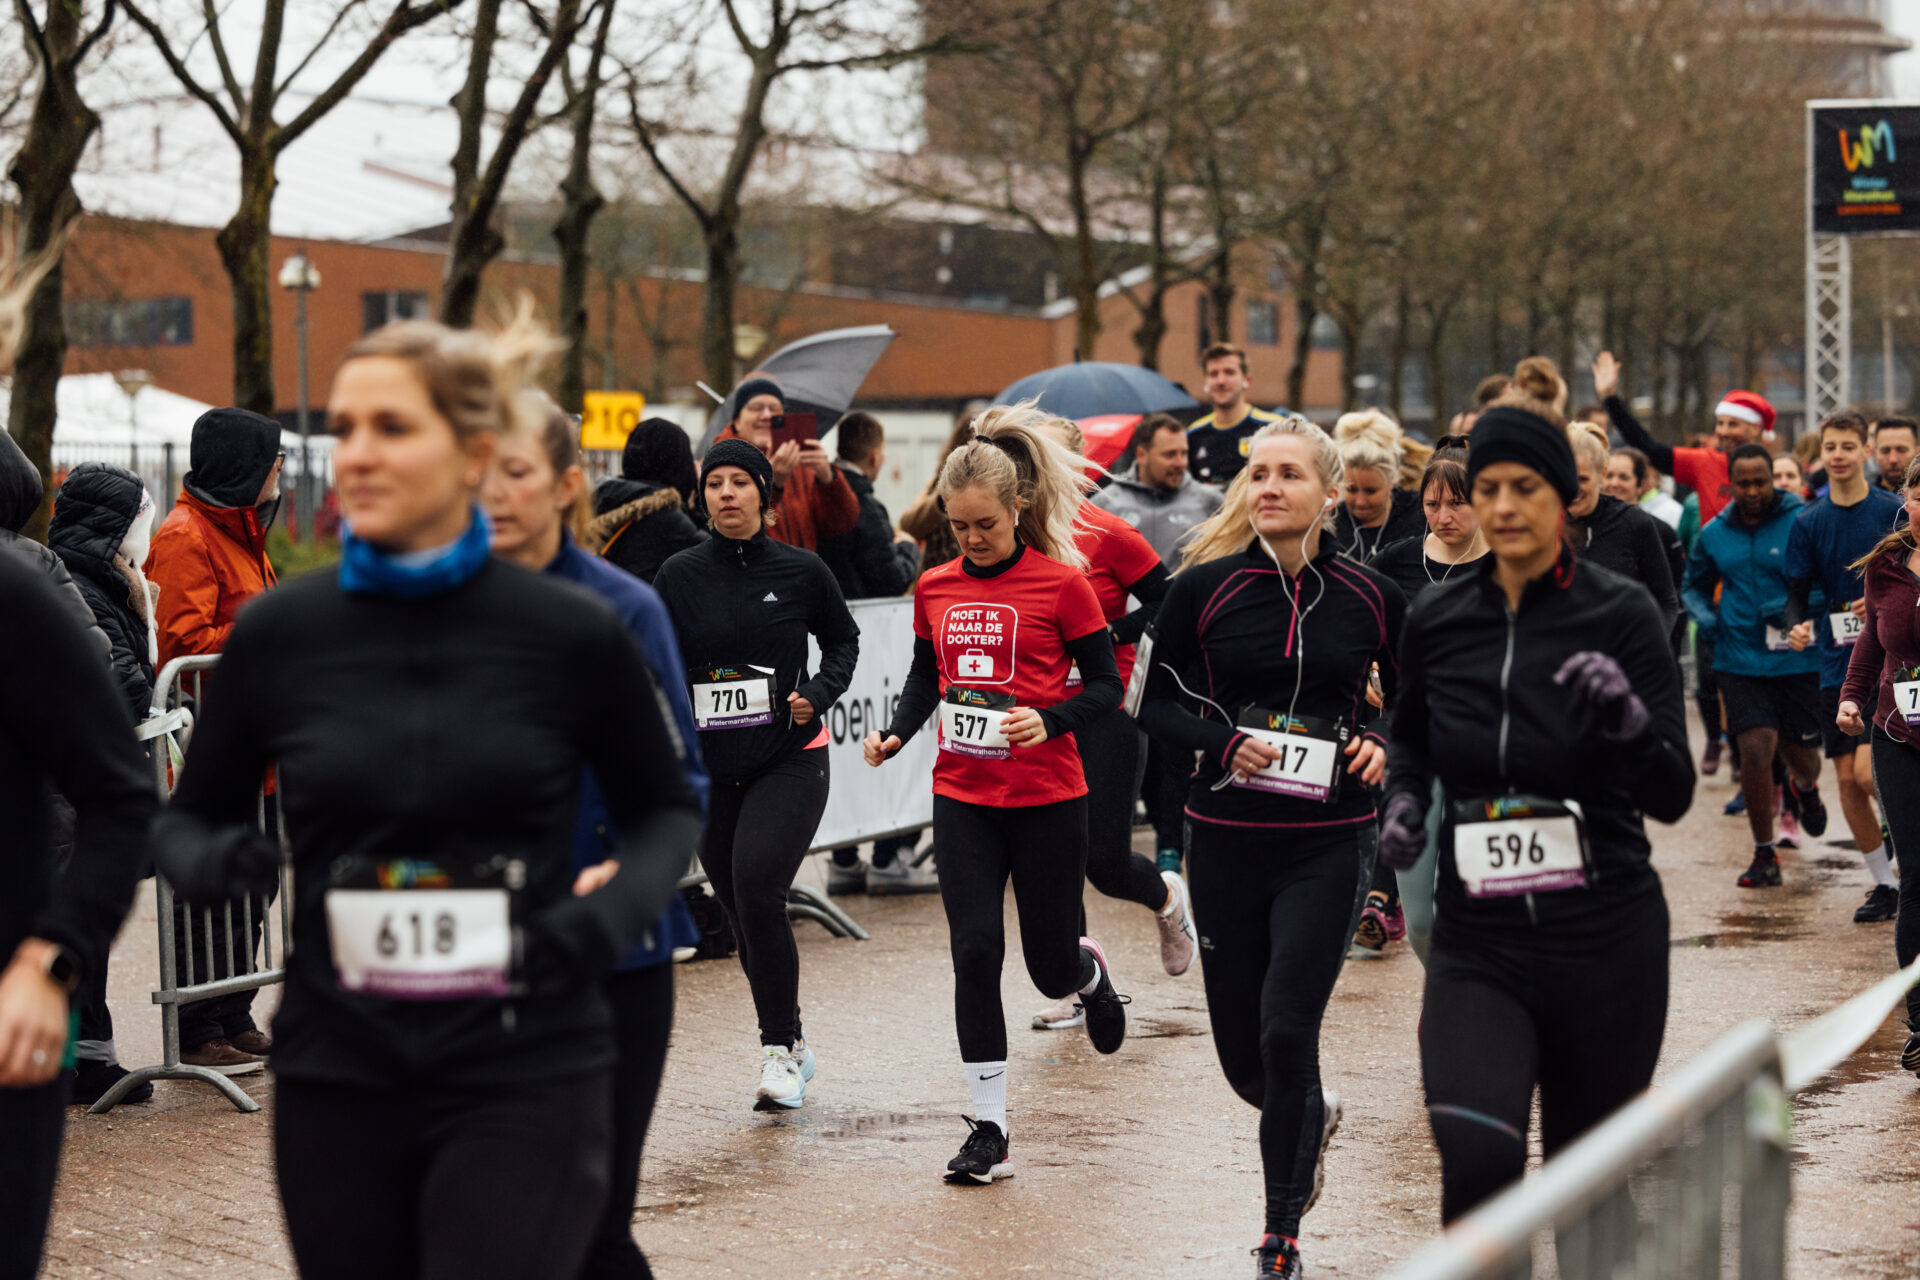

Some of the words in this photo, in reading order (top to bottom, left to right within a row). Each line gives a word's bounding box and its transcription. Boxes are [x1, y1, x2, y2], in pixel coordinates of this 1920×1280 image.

[948, 622, 983, 633] NAAR
[985, 623, 1003, 633] DE
[950, 609, 983, 621] MOET
[985, 610, 1000, 621] IK
[946, 634, 1004, 646] DOKTER?
[711, 688, 748, 713] 770
[708, 714, 769, 727] Wintermarathon.frl
[823, 696, 877, 746] oen
[954, 712, 988, 741] 577
[1263, 741, 1309, 774] 17
[1487, 829, 1545, 869] 596
[376, 912, 456, 959] 618
